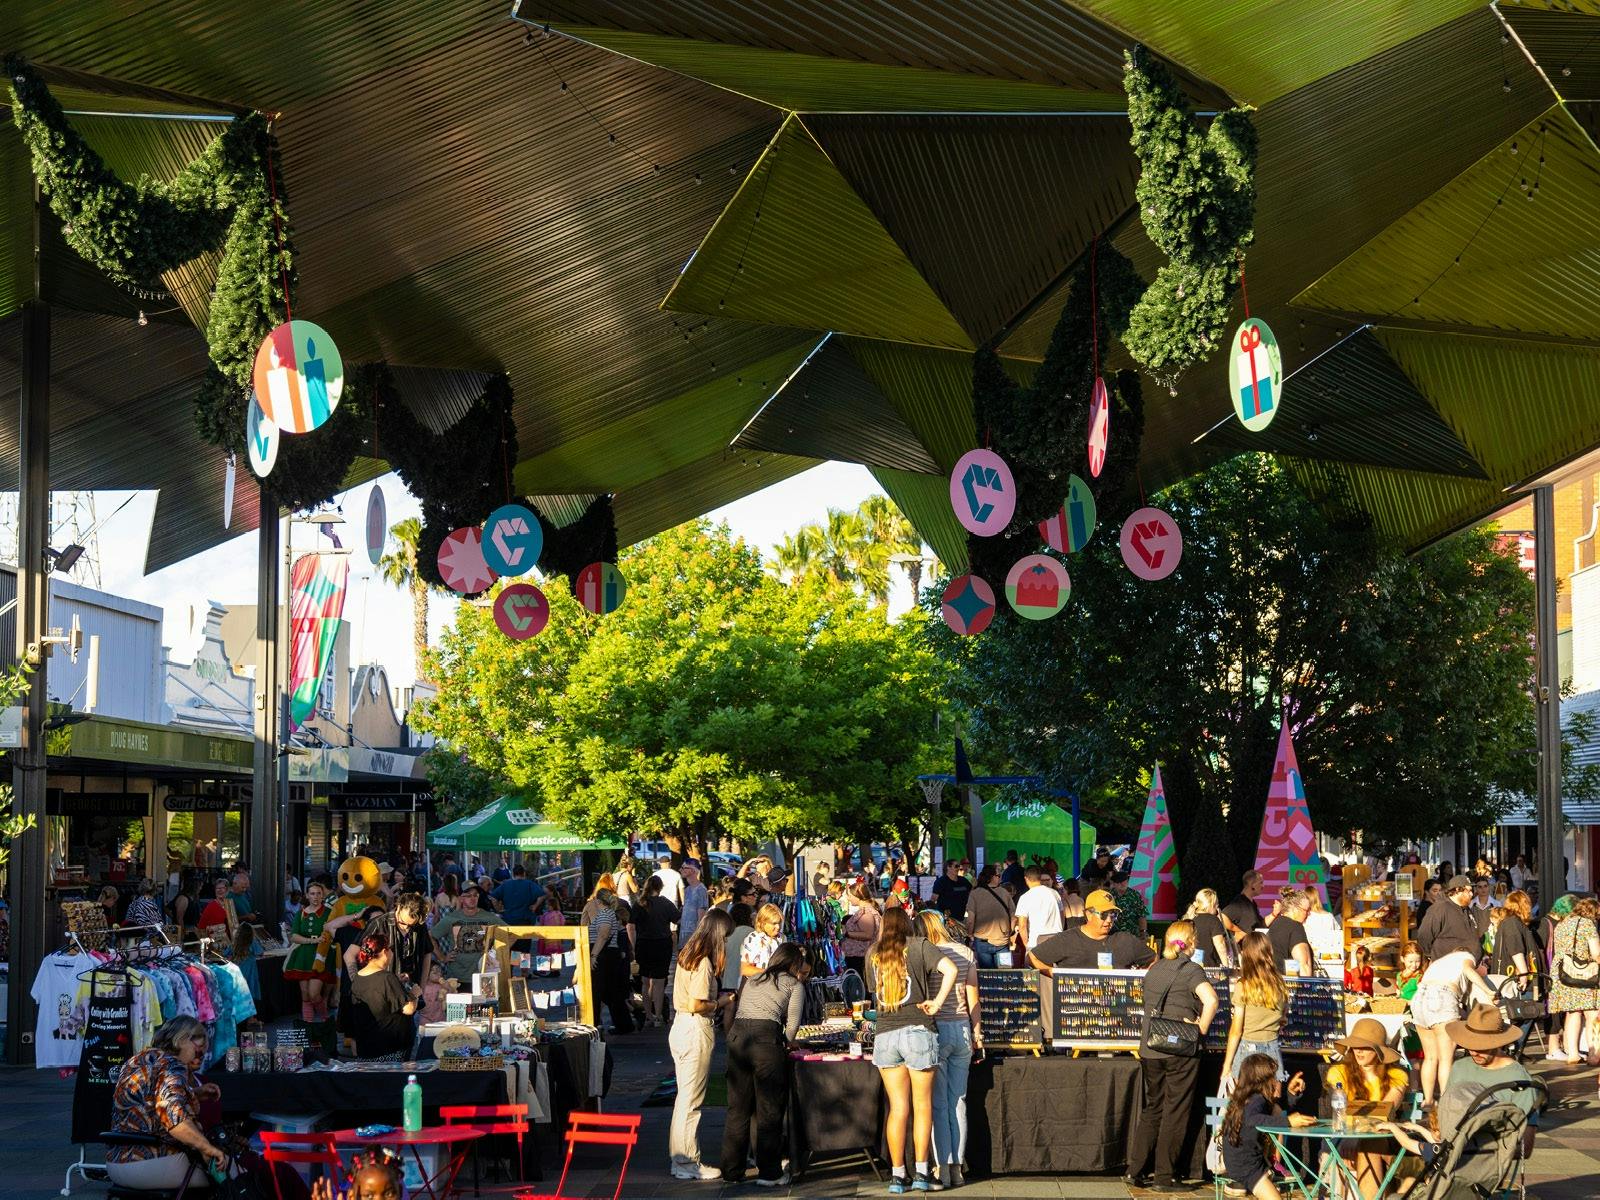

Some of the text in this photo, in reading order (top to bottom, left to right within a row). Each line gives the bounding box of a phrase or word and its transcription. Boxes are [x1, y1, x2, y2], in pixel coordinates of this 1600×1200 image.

[110, 731, 149, 751] DOUG HAYNES
[168, 797, 226, 810] Surf Crew
[345, 796, 397, 808] GAZMAN
